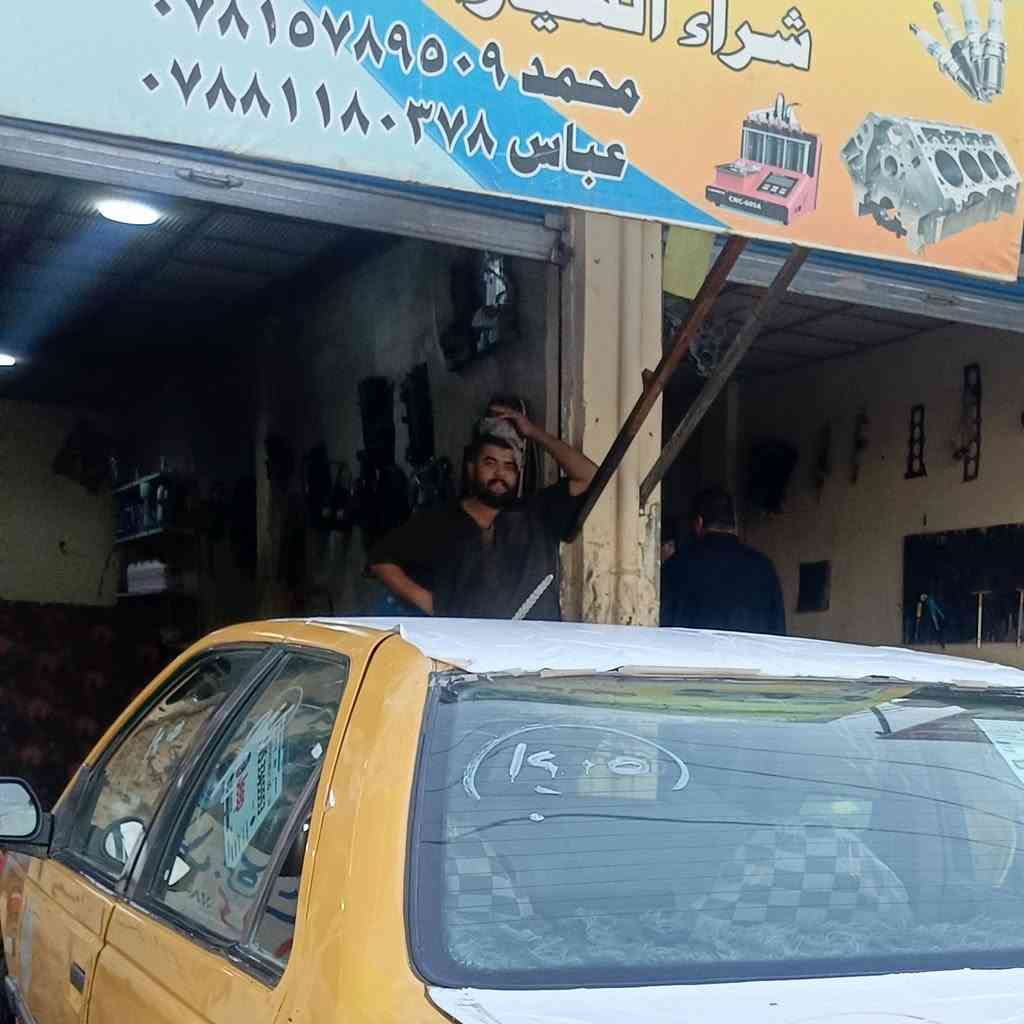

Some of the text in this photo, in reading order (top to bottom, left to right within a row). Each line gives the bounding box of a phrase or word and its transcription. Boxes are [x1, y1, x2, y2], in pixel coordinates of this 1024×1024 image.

[677, 0, 812, 71] شراء
[519, 54, 641, 116] محمد
[141, 58, 628, 187] عباس ٠٧٨٨١١٨٠٣٧٨
